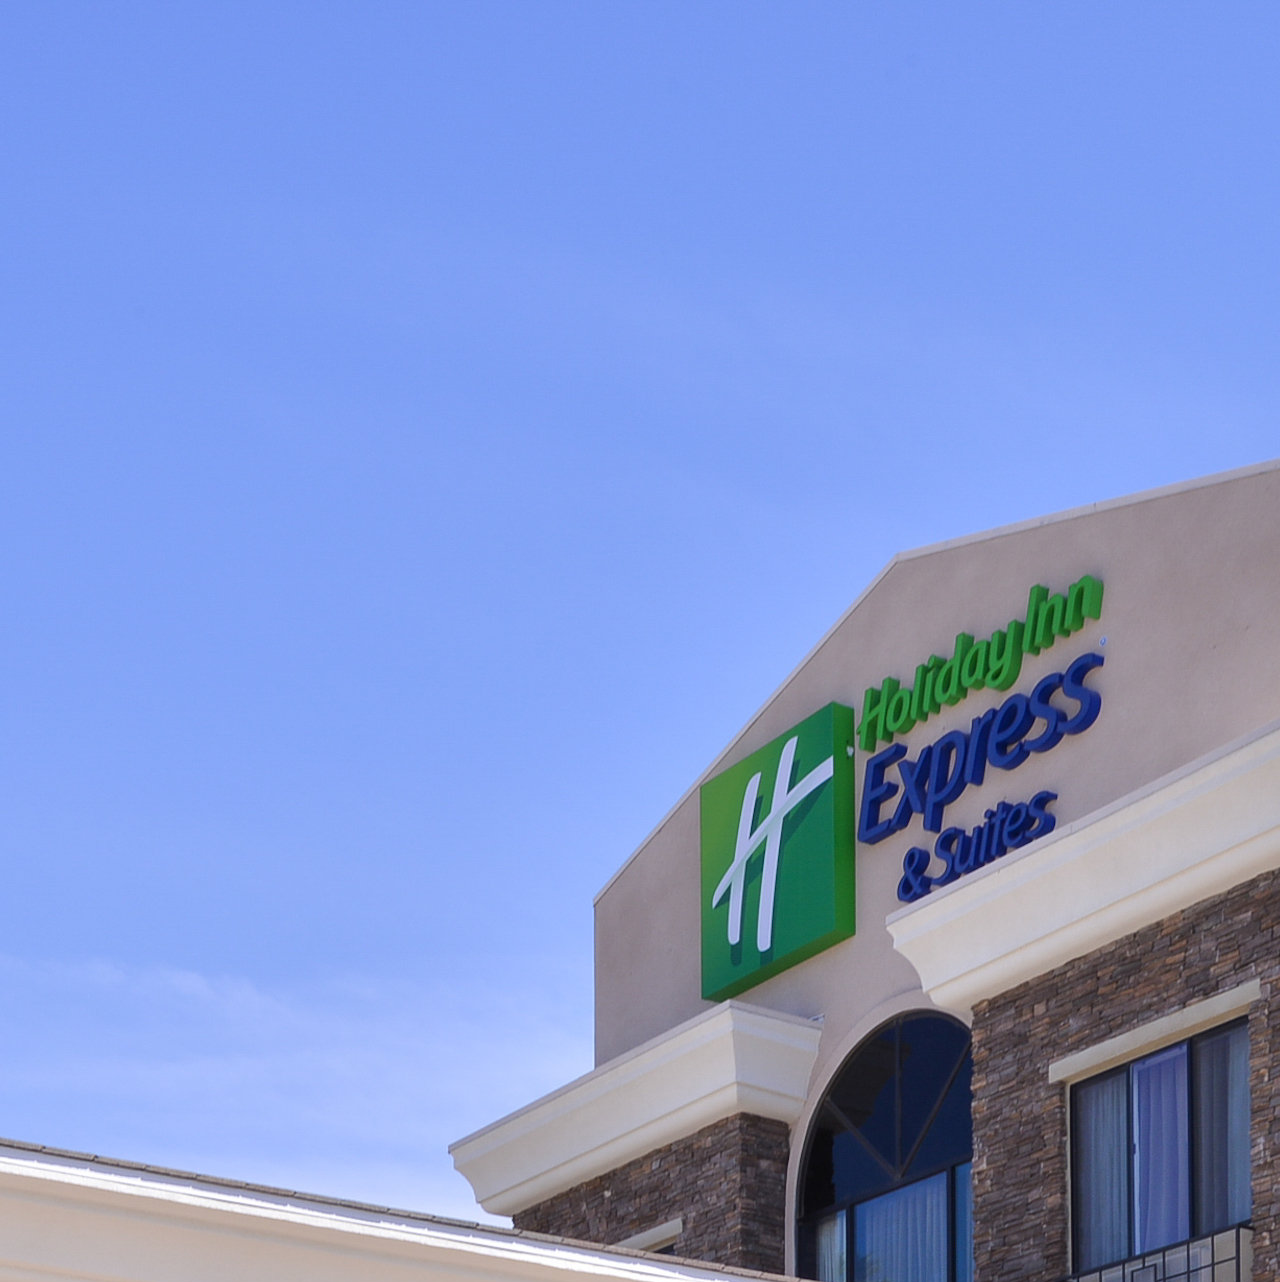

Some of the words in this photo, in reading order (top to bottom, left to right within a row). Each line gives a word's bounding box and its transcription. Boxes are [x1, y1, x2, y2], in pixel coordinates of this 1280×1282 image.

[857, 619, 1025, 752] Holiday
[1023, 574, 1104, 655] Inn
[857, 652, 1105, 844] Express
[931, 790, 1058, 886] Suites
